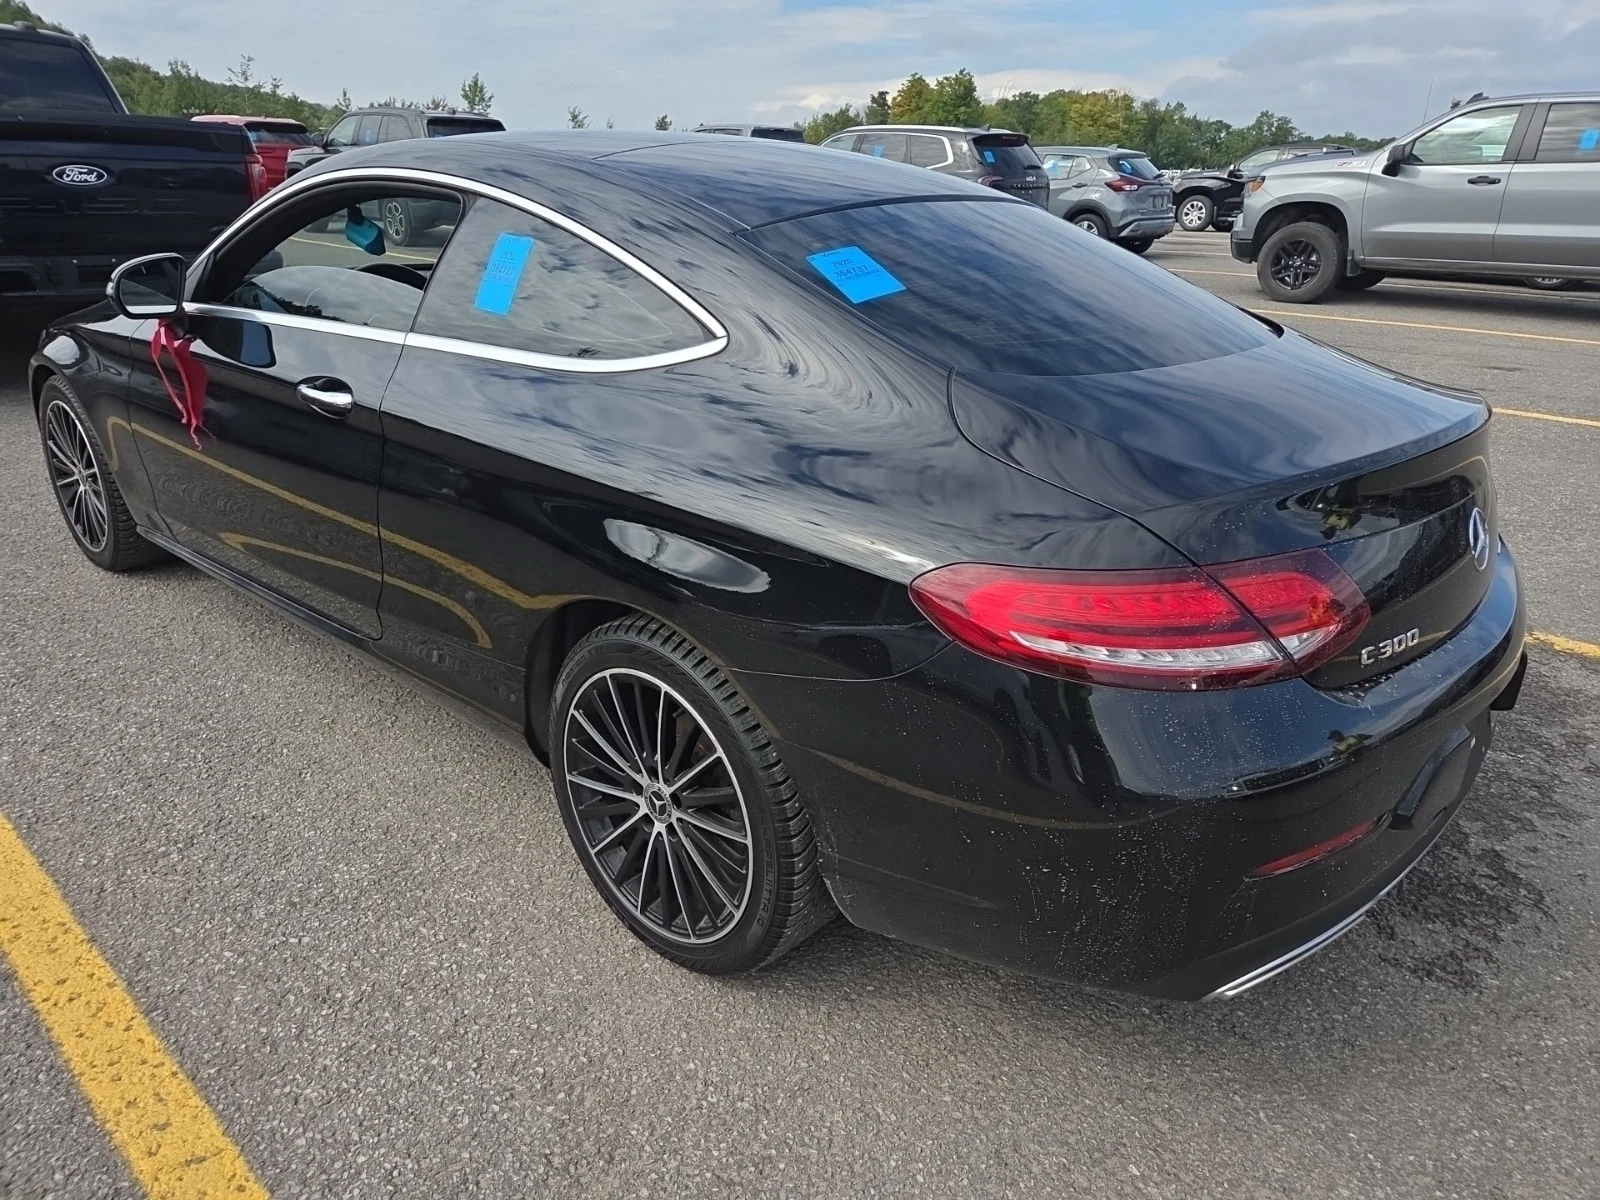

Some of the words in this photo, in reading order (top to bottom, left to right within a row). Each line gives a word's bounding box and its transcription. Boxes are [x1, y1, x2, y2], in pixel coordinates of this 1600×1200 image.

[63, 167, 97, 182] Ford
[833, 264, 868, 278] 364737
[1361, 646, 1375, 665] C
[1378, 628, 1419, 659] 300
